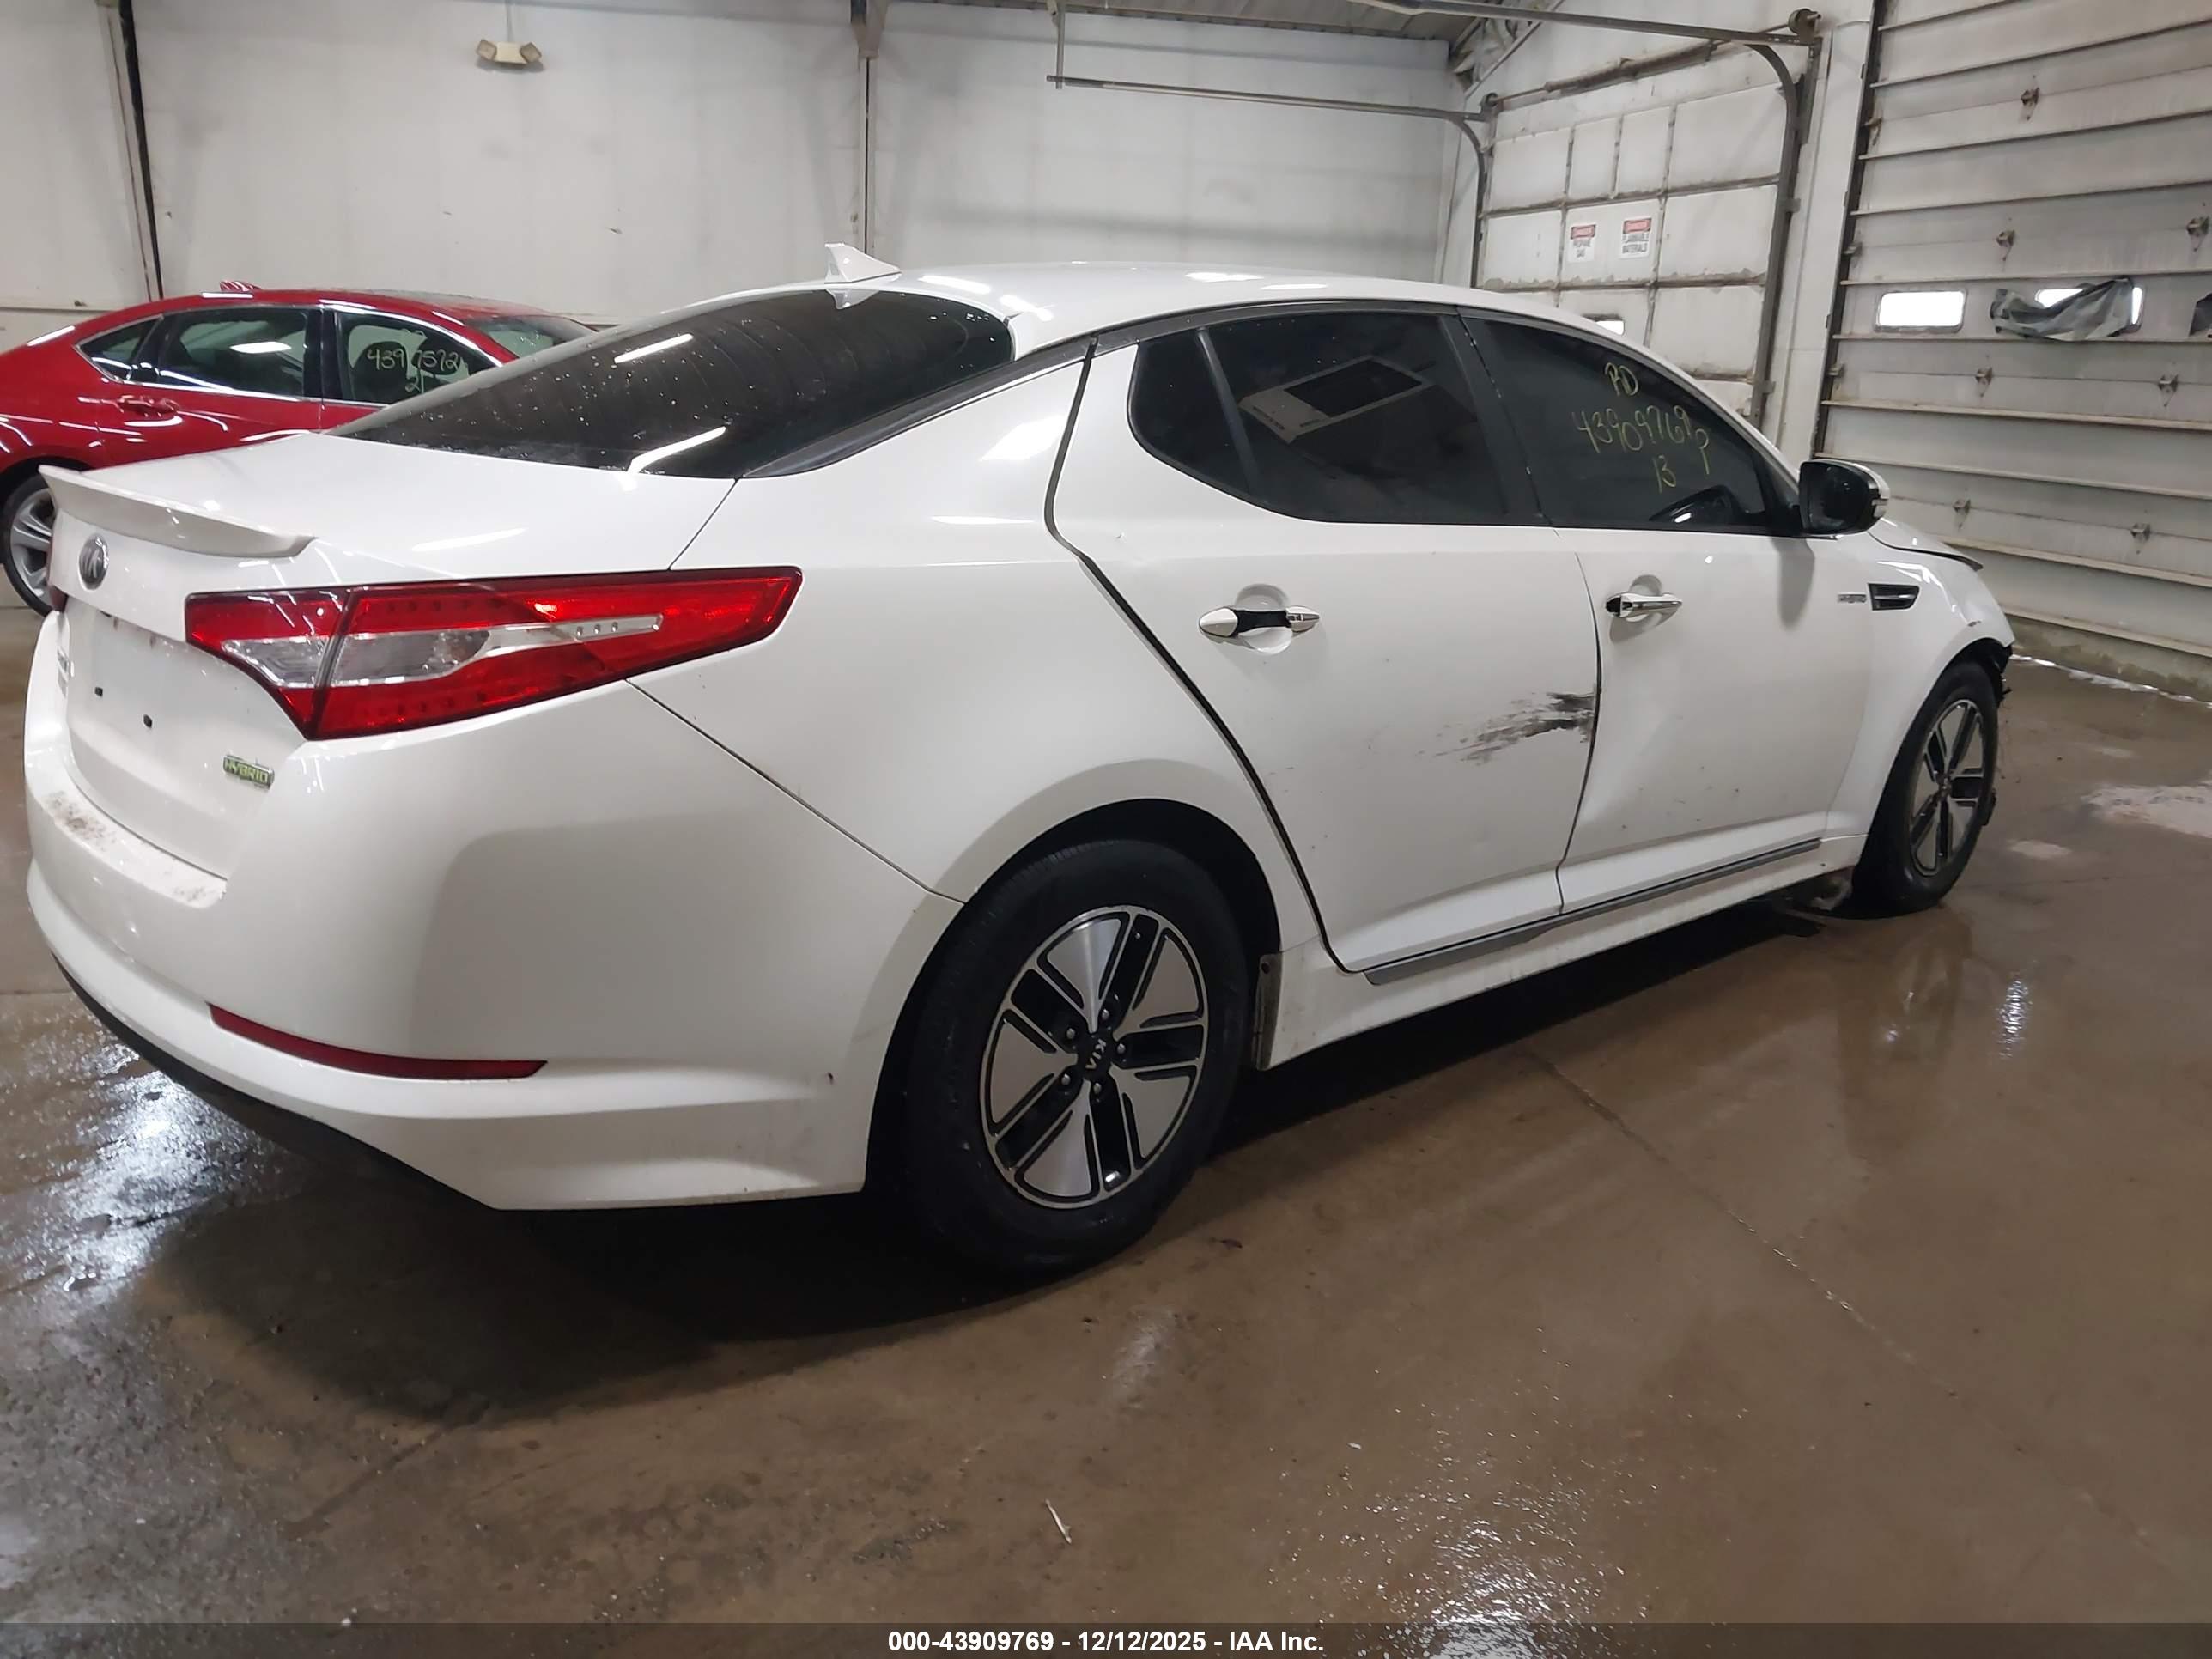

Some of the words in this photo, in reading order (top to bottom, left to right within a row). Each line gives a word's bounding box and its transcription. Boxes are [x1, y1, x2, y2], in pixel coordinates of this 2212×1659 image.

[1571, 404, 1692, 454] 43909769
[224, 758, 269, 784] HYBRID
[1085, 1038, 1107, 1070] KIA
